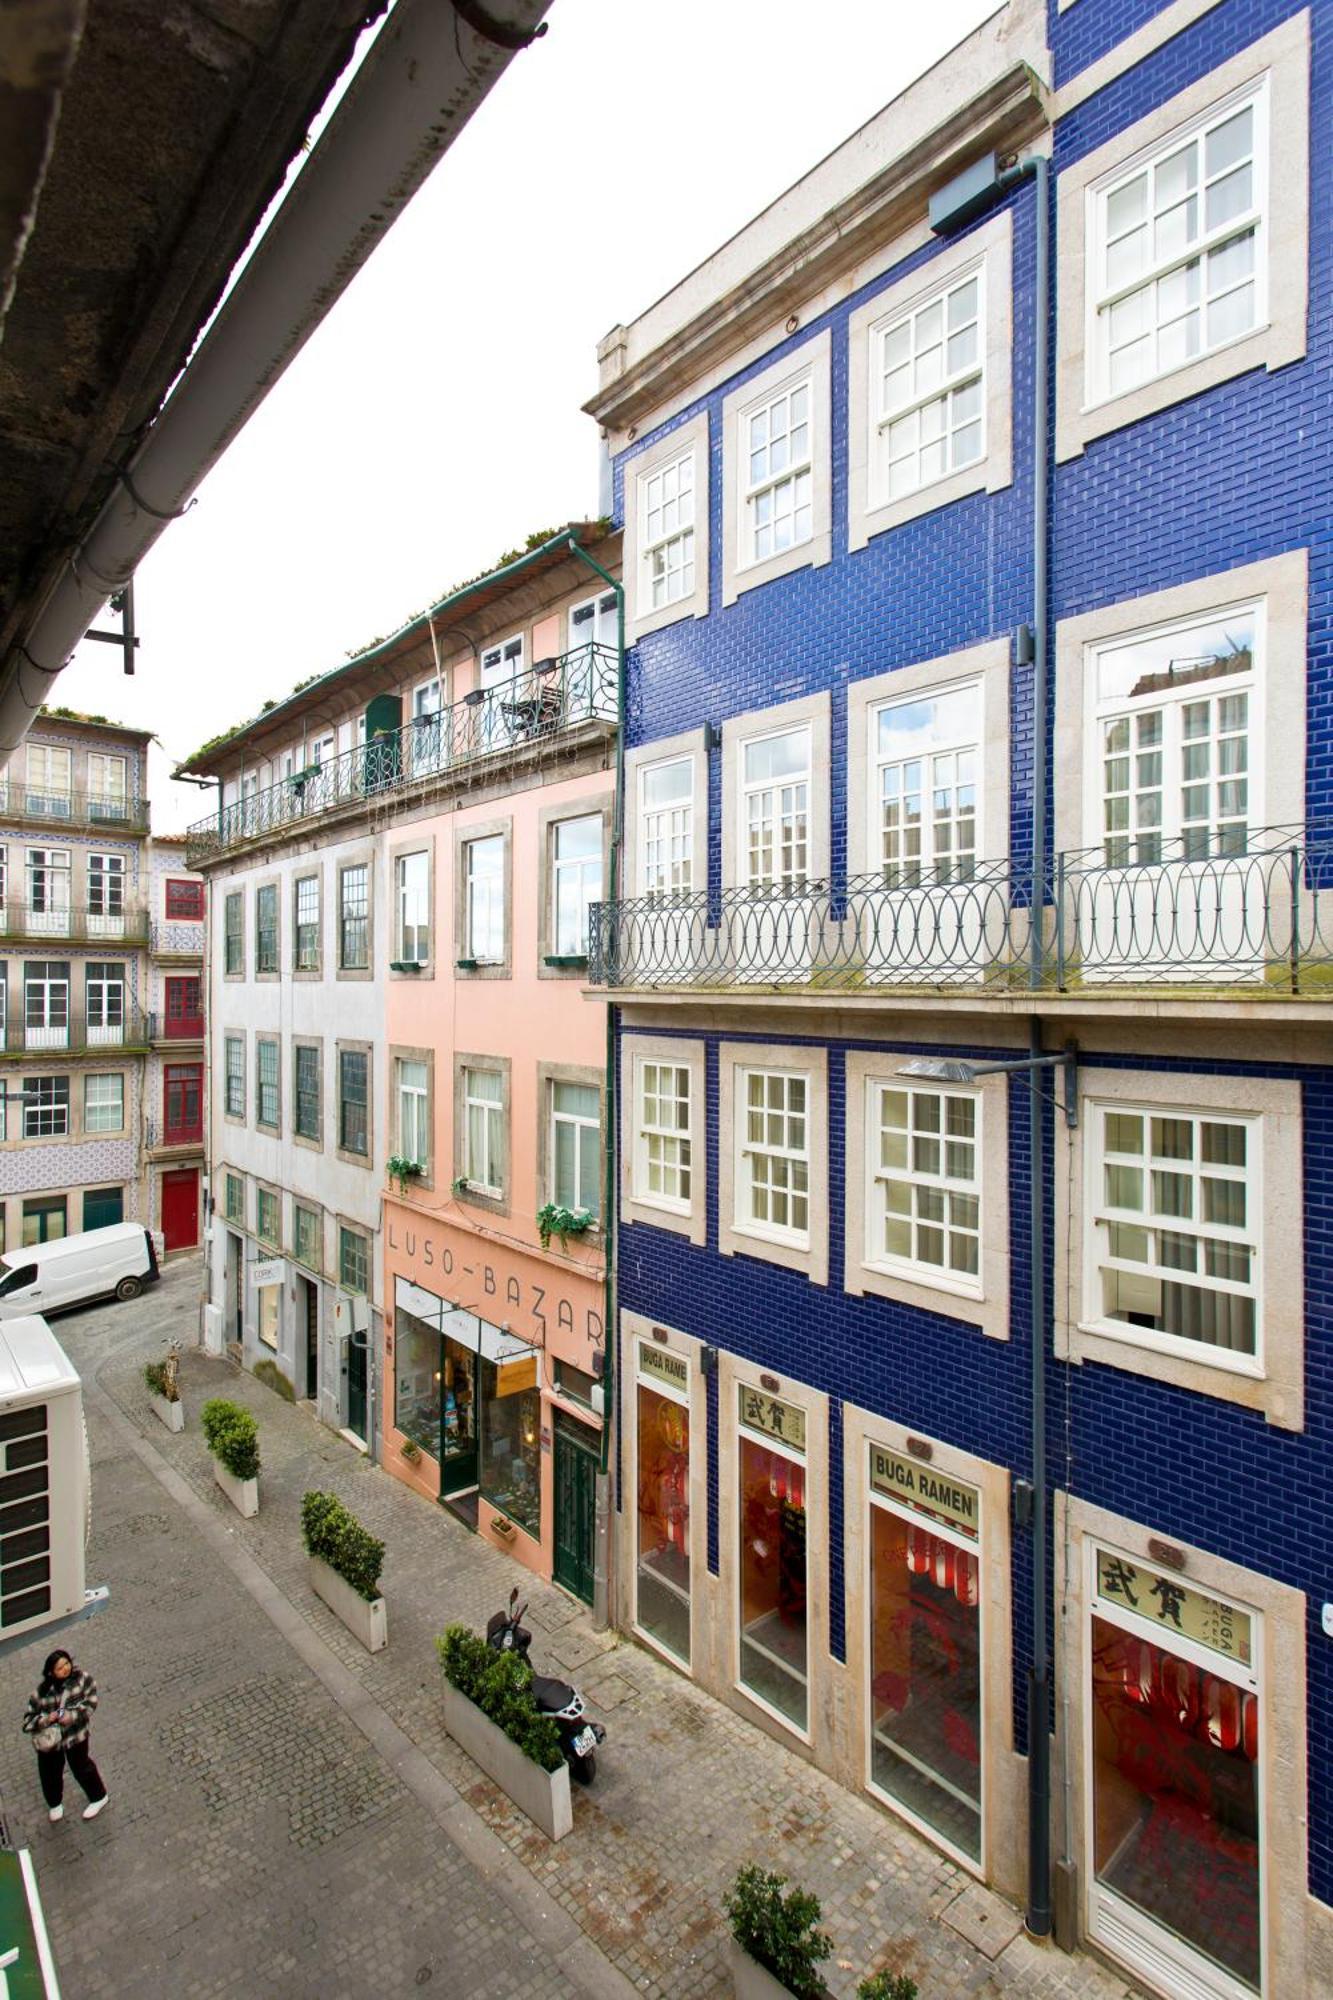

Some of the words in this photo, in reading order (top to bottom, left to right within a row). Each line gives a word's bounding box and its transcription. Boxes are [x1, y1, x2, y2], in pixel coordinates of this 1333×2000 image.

[388, 1223, 602, 1346] LUSO-BAZAR
[643, 1348, 663, 1370] BUGA
[664, 1358, 688, 1381] RAME
[876, 1454, 915, 1491] BUGA
[919, 1474, 973, 1517] RAMEN
[1219, 1602, 1233, 1650] BUGA
